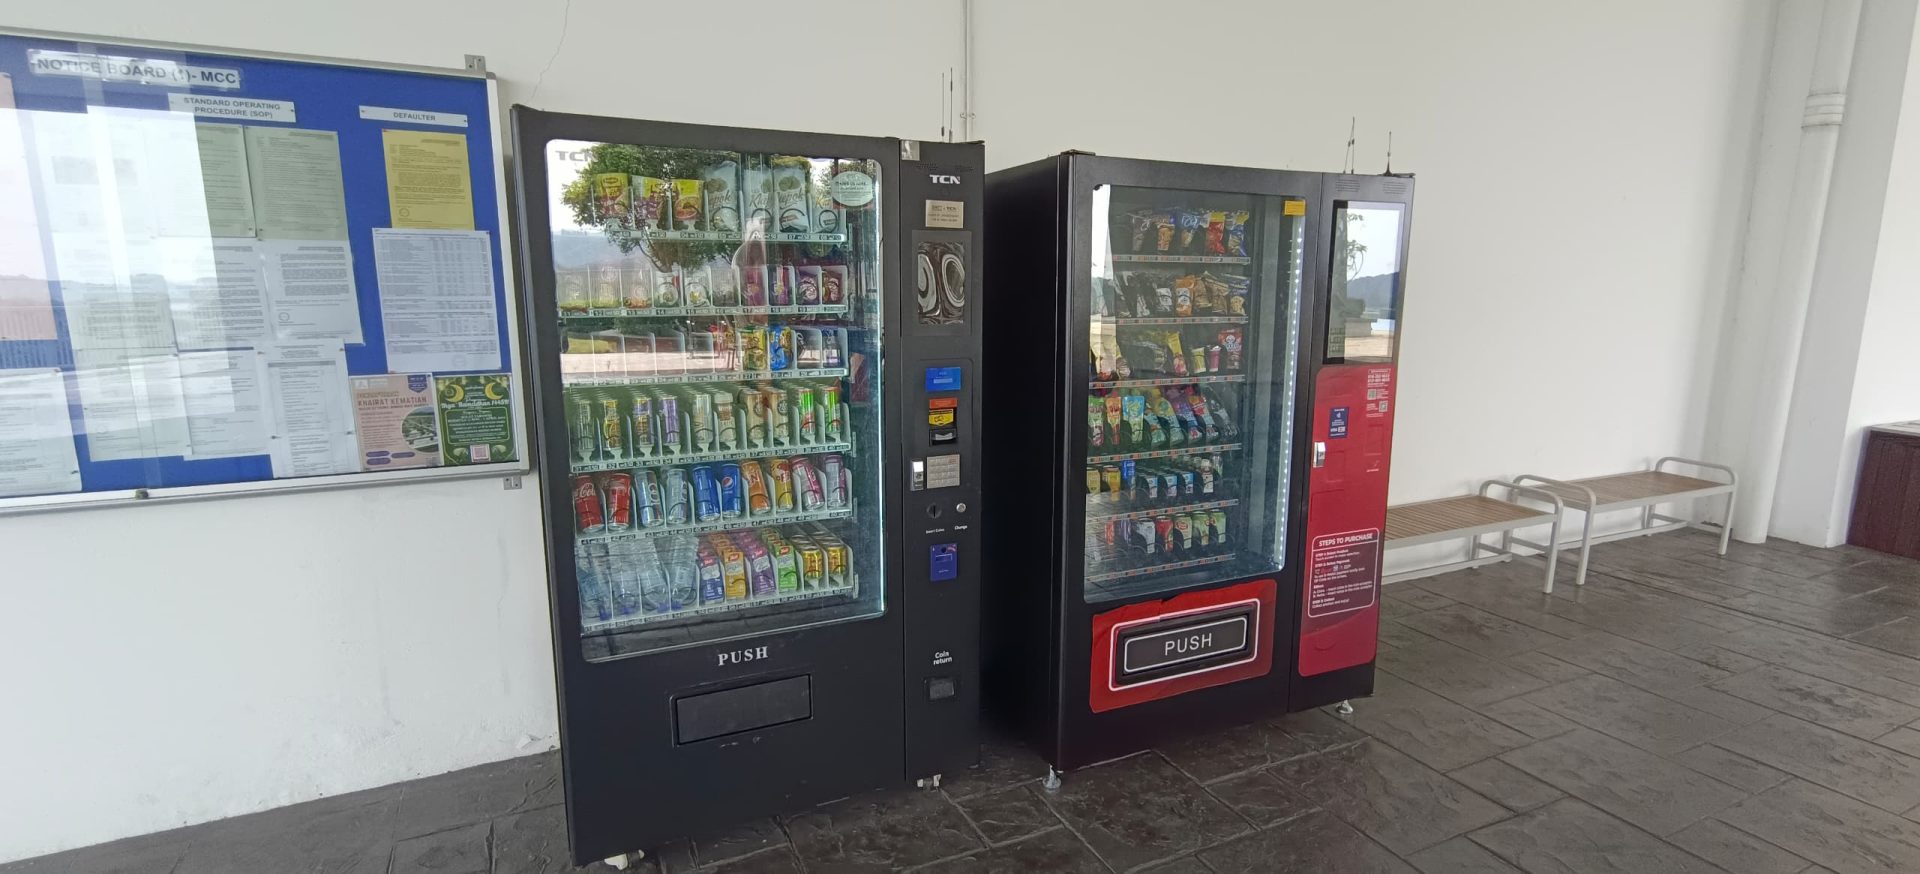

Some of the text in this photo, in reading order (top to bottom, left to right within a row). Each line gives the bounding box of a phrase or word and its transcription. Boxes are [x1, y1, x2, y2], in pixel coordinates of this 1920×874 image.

[36, 58, 101, 74] NOTICE
[107, 61, 167, 78] BOARD
[201, 71, 236, 84] MCC
[184, 97, 281, 110] STANDARD OPERATING
[194, 106, 274, 119] PROCEDURE (SOP)
[392, 111, 436, 121] DEFAULTER
[929, 174, 960, 184] TCN
[1318, 538, 1335, 547] STEPS
[1344, 532, 1373, 543] PURCHASE
[1165, 632, 1212, 656] PUSH
[718, 646, 768, 666] PUSH
